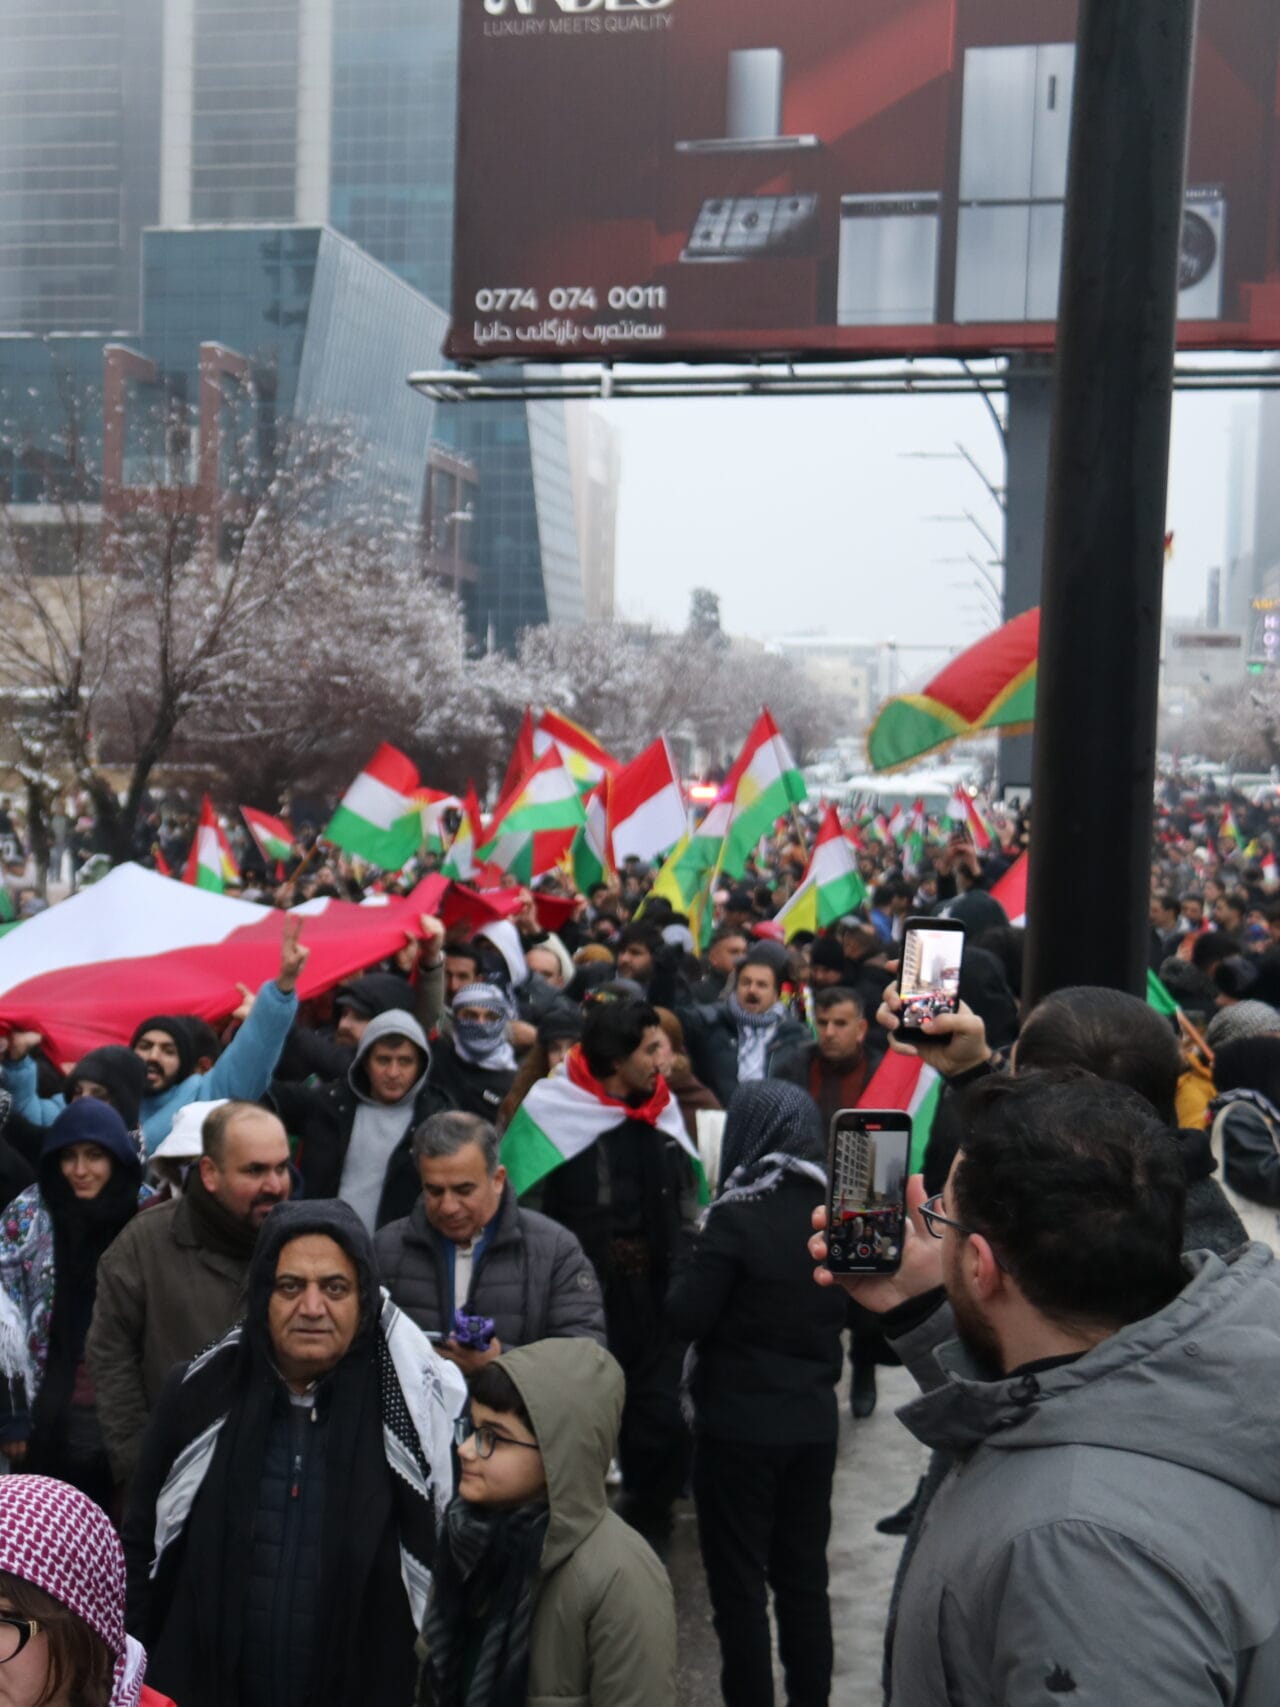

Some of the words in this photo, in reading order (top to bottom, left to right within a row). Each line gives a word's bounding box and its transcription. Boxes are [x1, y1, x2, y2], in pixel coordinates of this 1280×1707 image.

[483, 20, 543, 37] LUXURY
[548, 17, 601, 34] MEETS
[604, 14, 673, 32] QUALITY
[475, 288, 539, 312] 0774
[548, 287, 597, 310] 074
[608, 285, 667, 309] 0011
